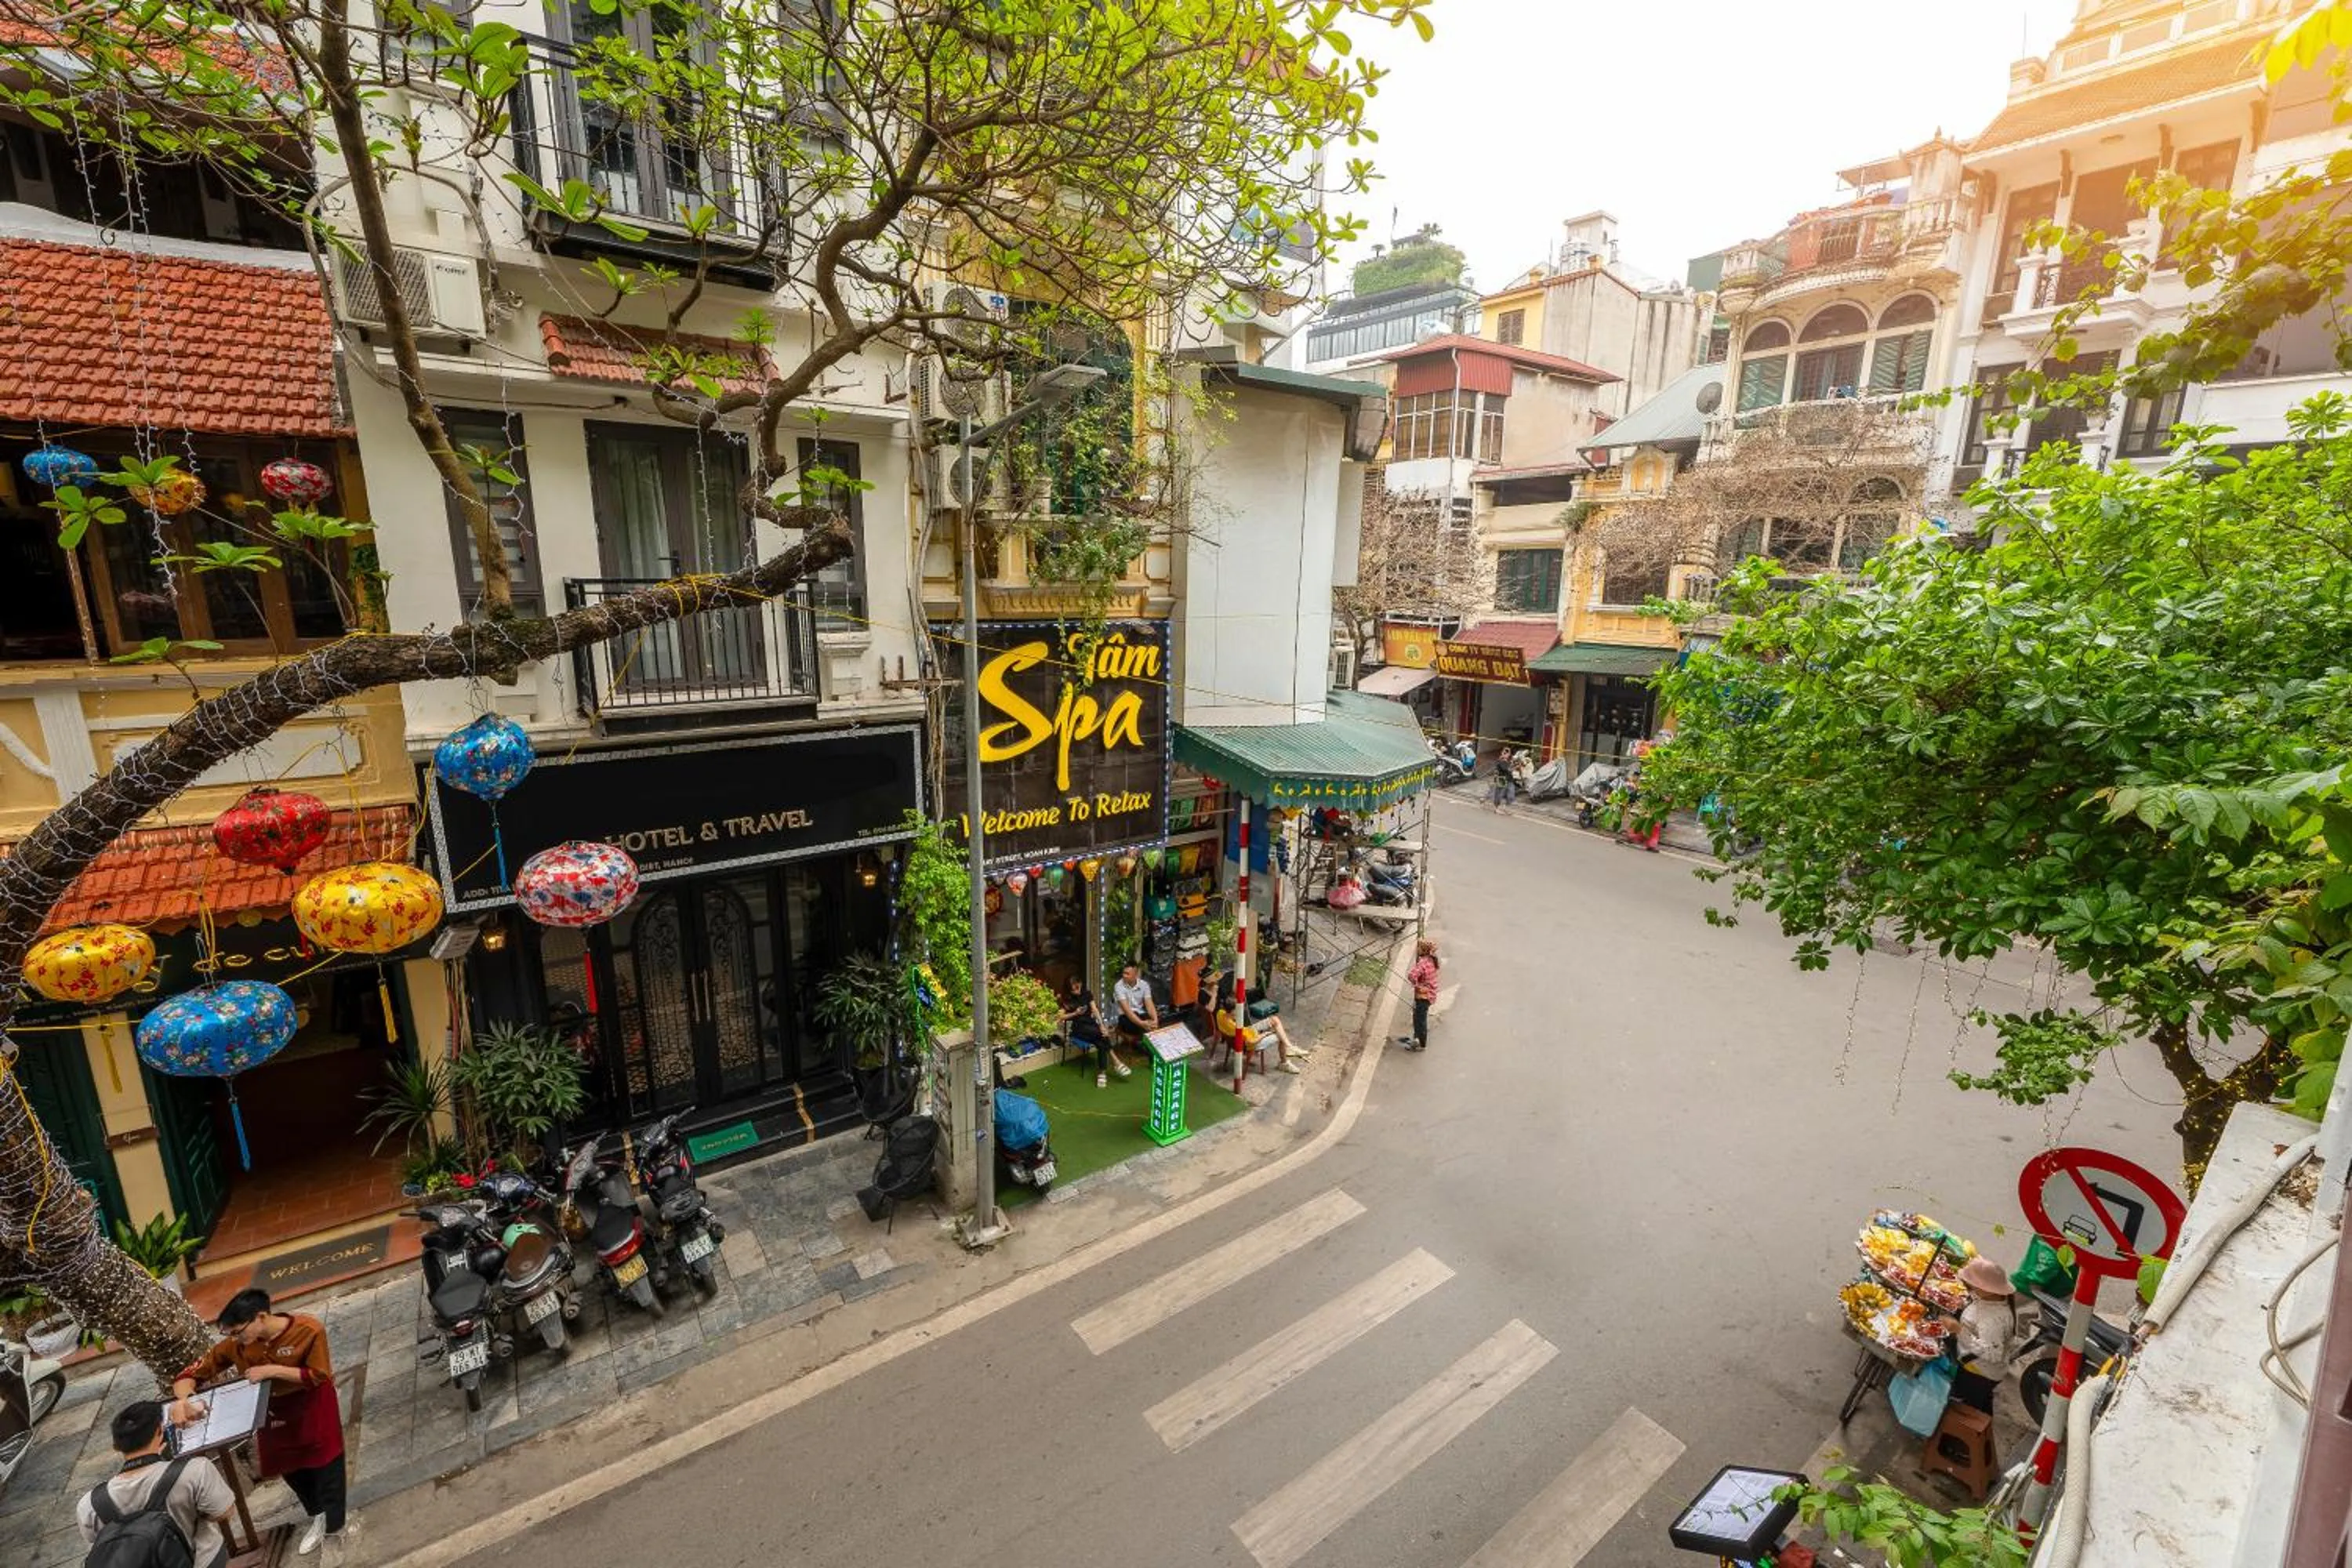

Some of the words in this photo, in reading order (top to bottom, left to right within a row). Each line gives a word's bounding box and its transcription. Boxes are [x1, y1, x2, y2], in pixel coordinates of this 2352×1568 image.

[1068, 633, 1161, 684] Tâm
[1437, 655, 1490, 676] QUANG
[978, 641, 1145, 791] Spa
[1067, 795, 1090, 822] To
[1096, 789, 1152, 818] Relax
[604, 825, 695, 852] HOTEL
[700, 822, 719, 841] &
[722, 808, 814, 839] TRAVEL
[269, 1242, 375, 1279] WELCOME
